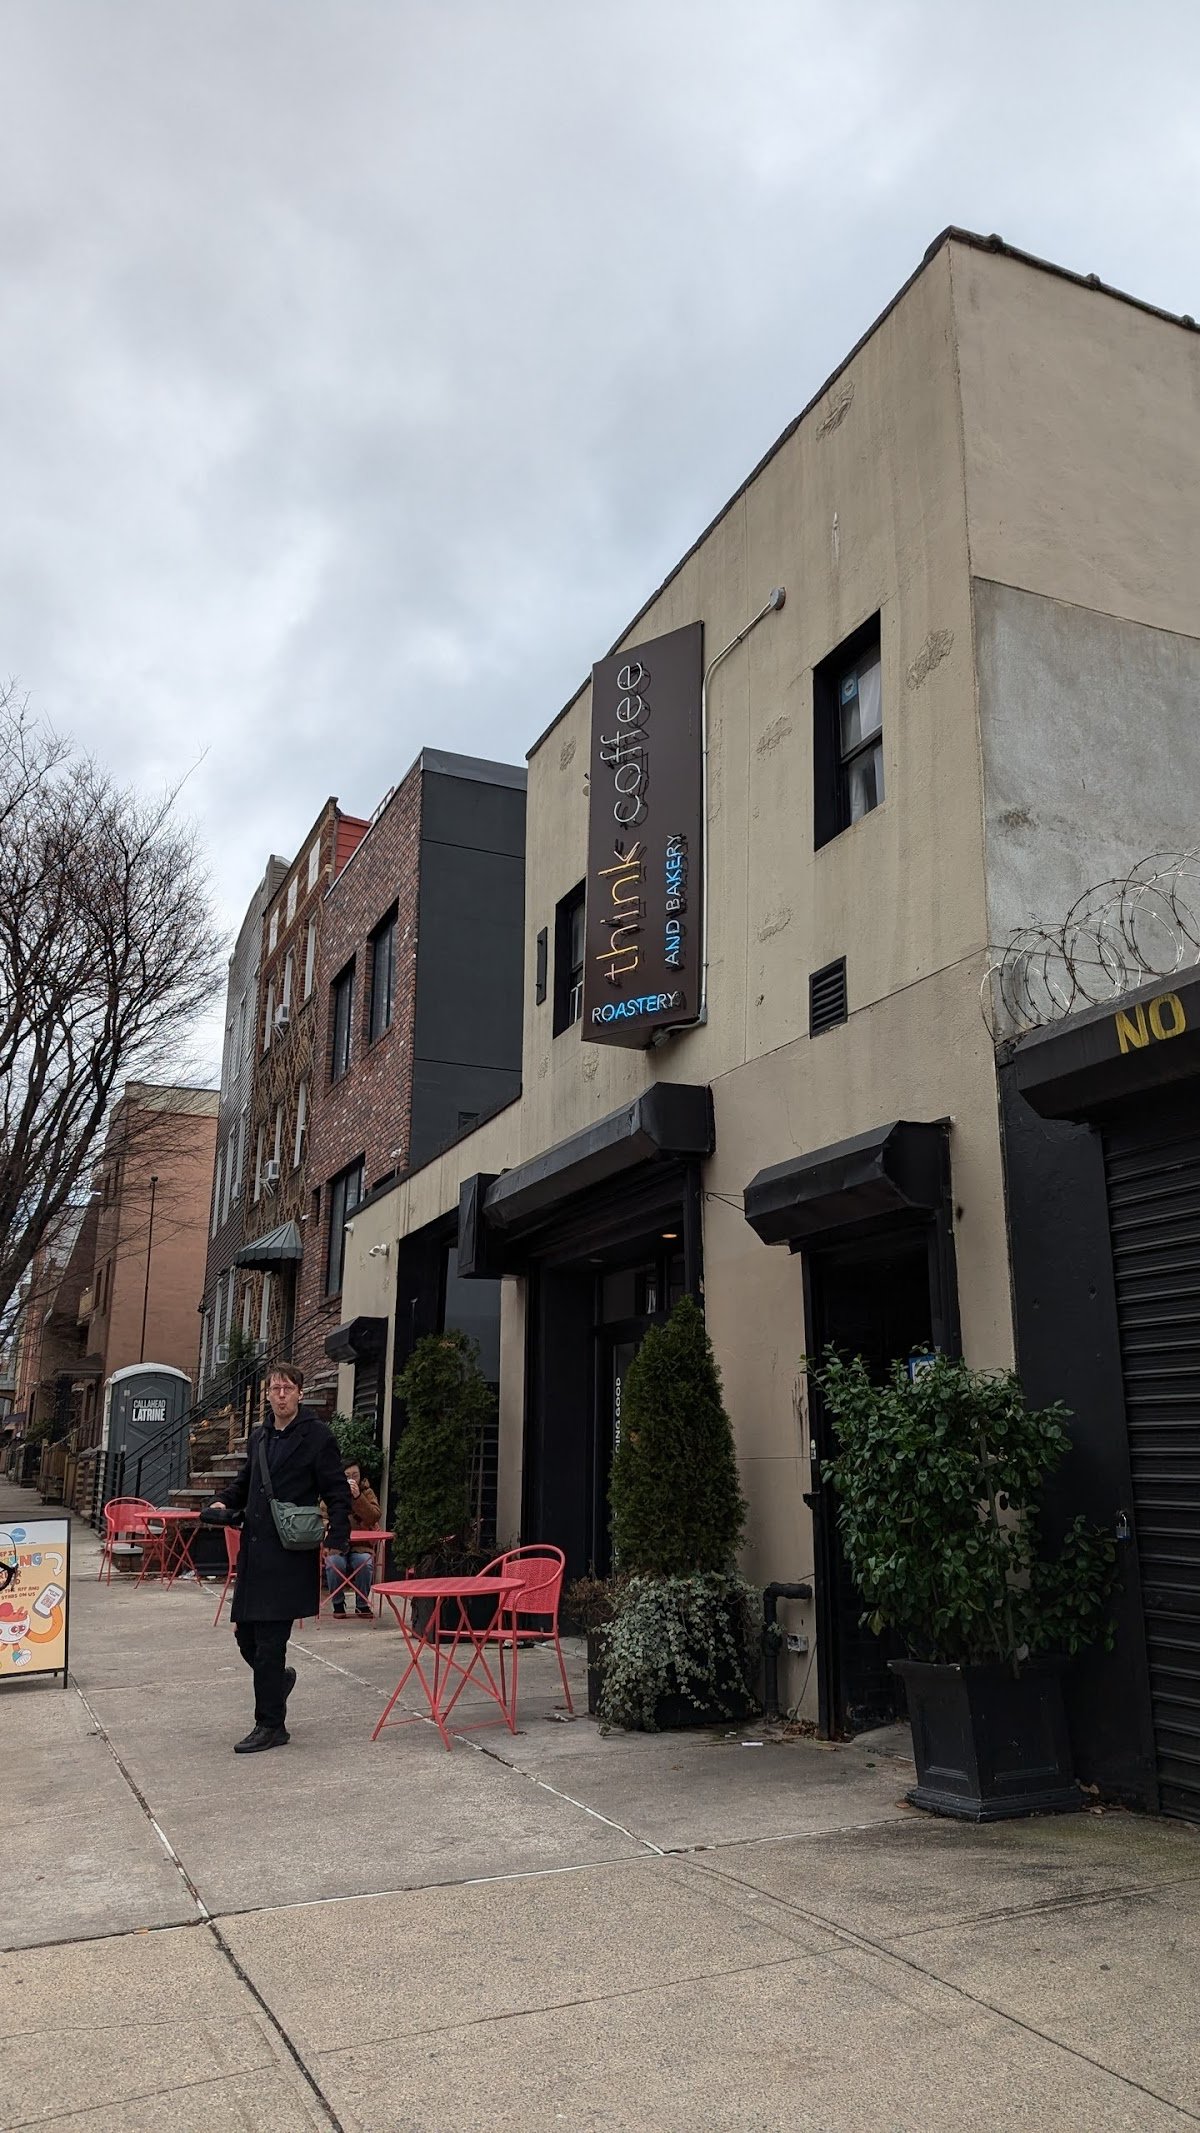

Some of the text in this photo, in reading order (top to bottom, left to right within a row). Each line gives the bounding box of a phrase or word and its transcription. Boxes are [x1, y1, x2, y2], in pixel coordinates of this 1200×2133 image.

[596, 662, 643, 980] think coffee
[665, 834, 682, 966] AND BAKERY
[592, 990, 679, 1024] ROASTERY
[1115, 992, 1186, 1053] NO
[132, 1408, 165, 1421] LATRINE
[133, 1399, 166, 1409] CALLAHEAD
